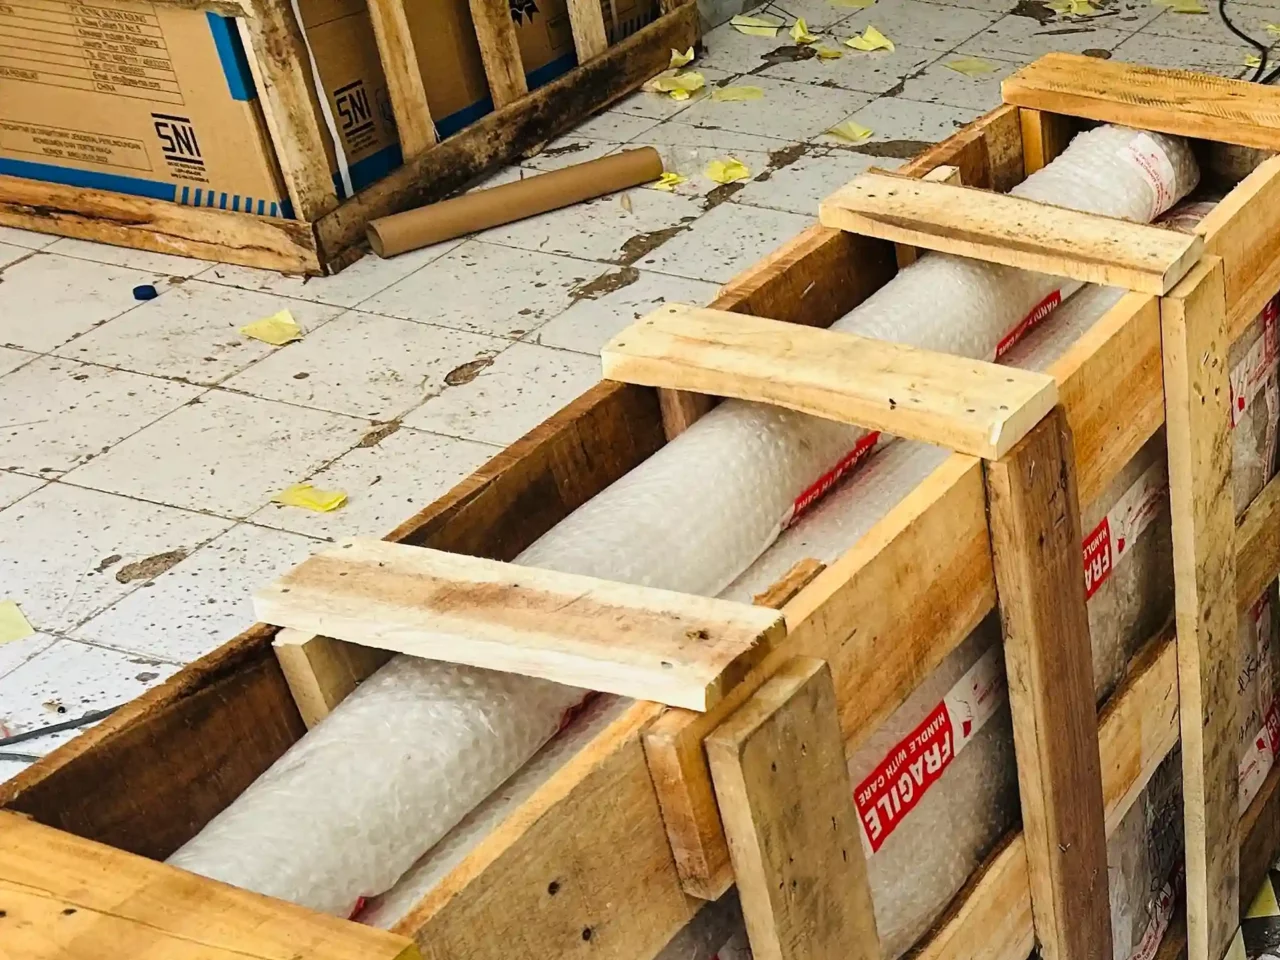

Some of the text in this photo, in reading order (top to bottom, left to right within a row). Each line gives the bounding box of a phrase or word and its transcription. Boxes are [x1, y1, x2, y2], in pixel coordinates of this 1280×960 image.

[336, 87, 372, 129] SNI
[154, 121, 202, 158] SNI
[1082, 527, 1108, 560] HANDLE
[858, 712, 946, 807] HANDLE WITH CARE
[865, 731, 951, 841] FRAGILE
